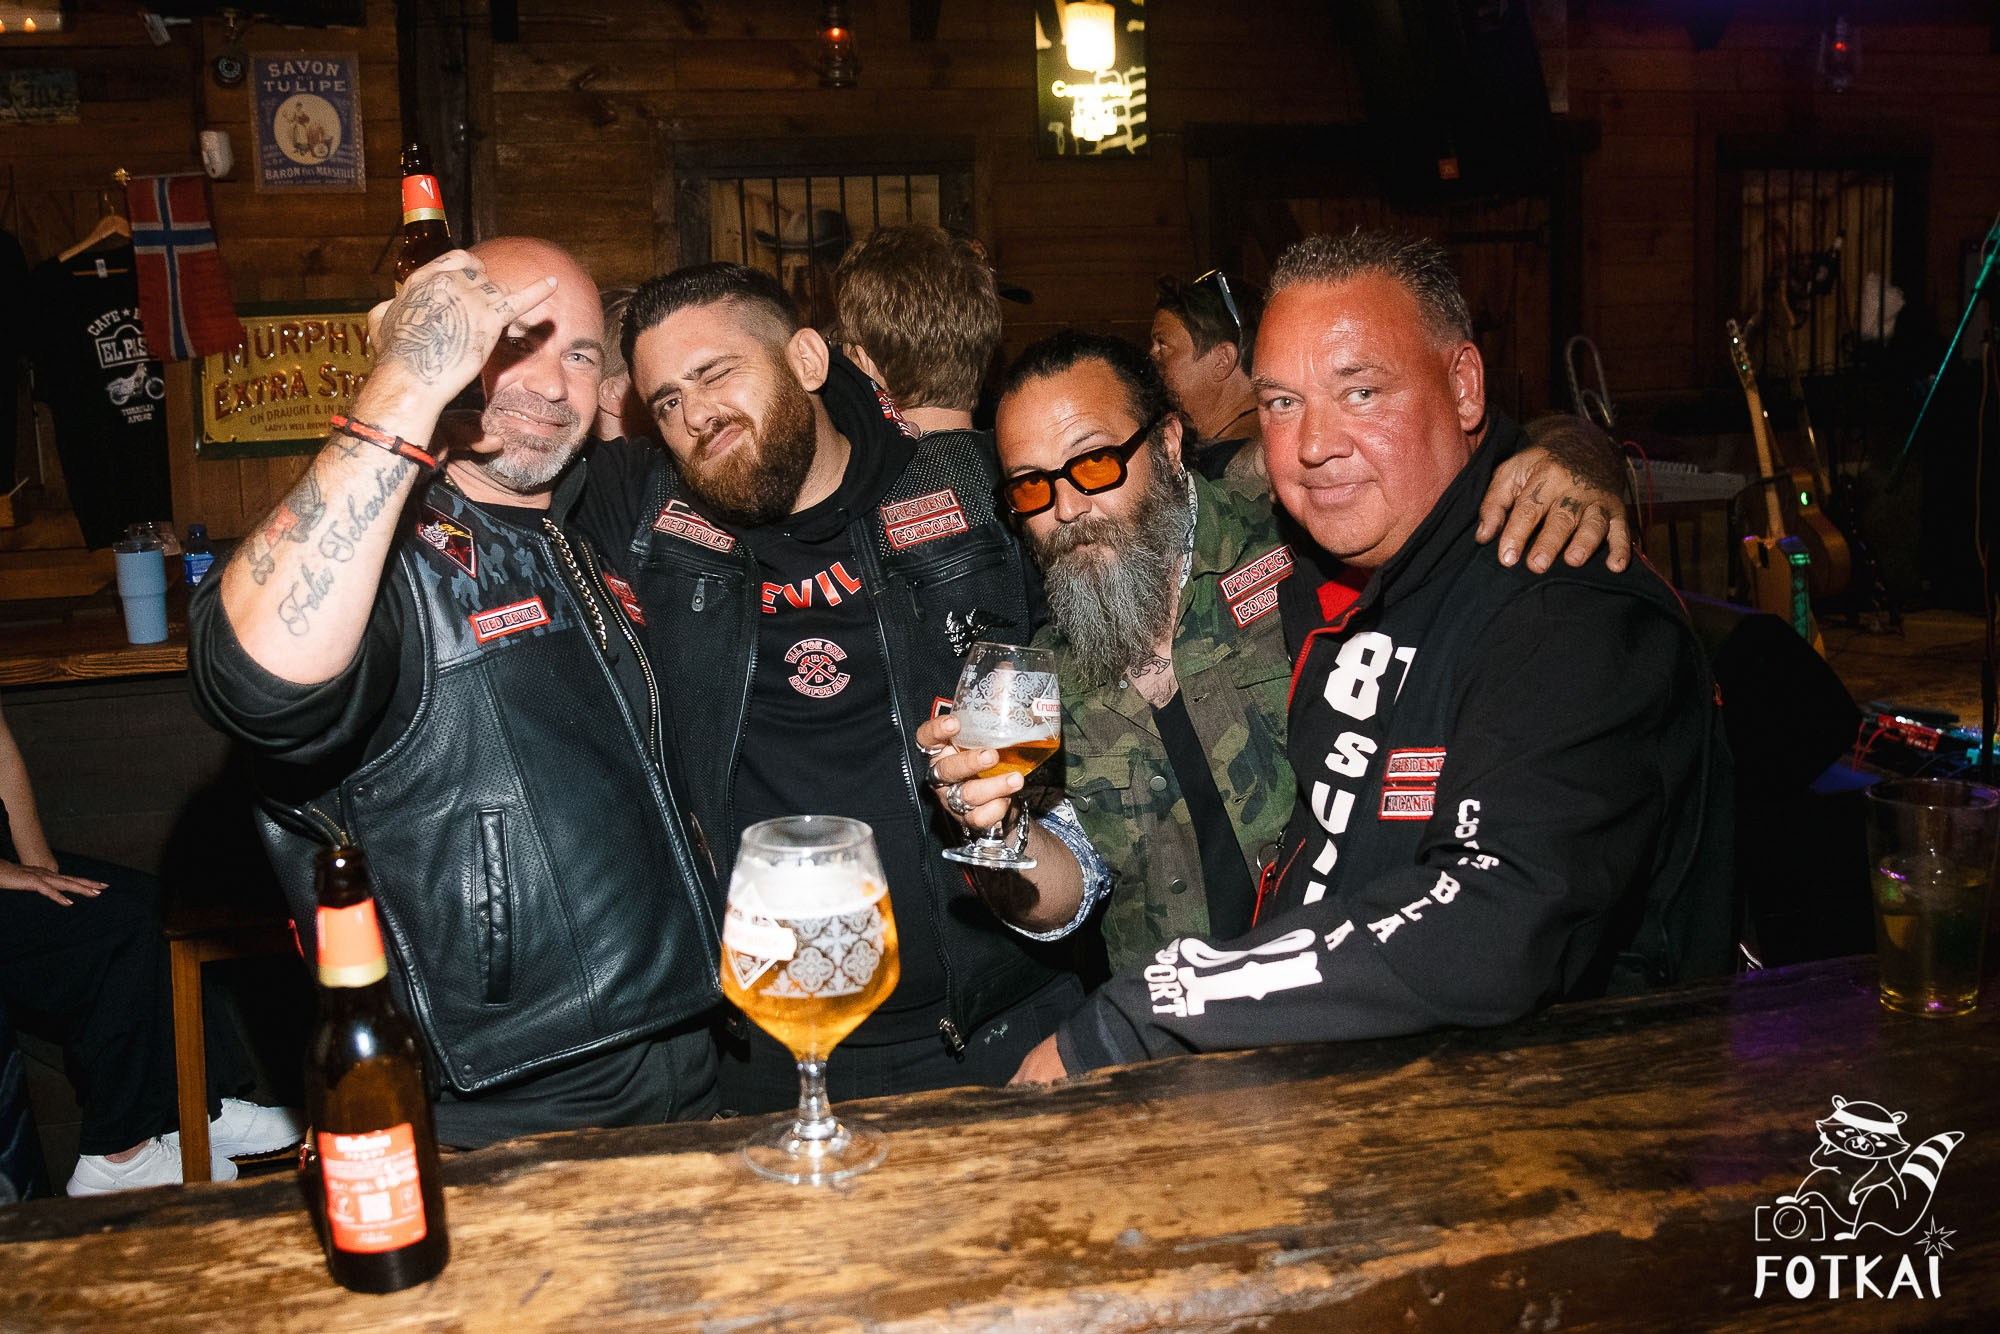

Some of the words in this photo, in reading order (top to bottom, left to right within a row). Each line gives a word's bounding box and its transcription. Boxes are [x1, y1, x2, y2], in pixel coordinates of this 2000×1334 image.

[268, 61, 340, 77] SAVON
[264, 81, 346, 92] TULIPE
[88, 310, 121, 336] CAFE
[101, 342, 123, 363] EL
[215, 367, 309, 421] EXTRA
[267, 404, 311, 420] DRAUGHT
[324, 403, 335, 415] IN
[887, 493, 951, 522] PRESIDENT
[660, 517, 686, 532] RED
[685, 524, 729, 548] DEVILS
[895, 513, 962, 543] CORDOBA
[1226, 549, 1292, 595] PROSPECT
[761, 562, 861, 613] EVIL
[1239, 586, 1279, 620] CORD
[480, 617, 503, 635] RED
[503, 606, 541, 628] DEVILS
[788, 646, 803, 662] ALL
[801, 640, 822, 651] FOR
[824, 642, 845, 661] ONE
[791, 676, 811, 693] ONE
[811, 687, 833, 697] FOR
[832, 675, 848, 691] ALL
